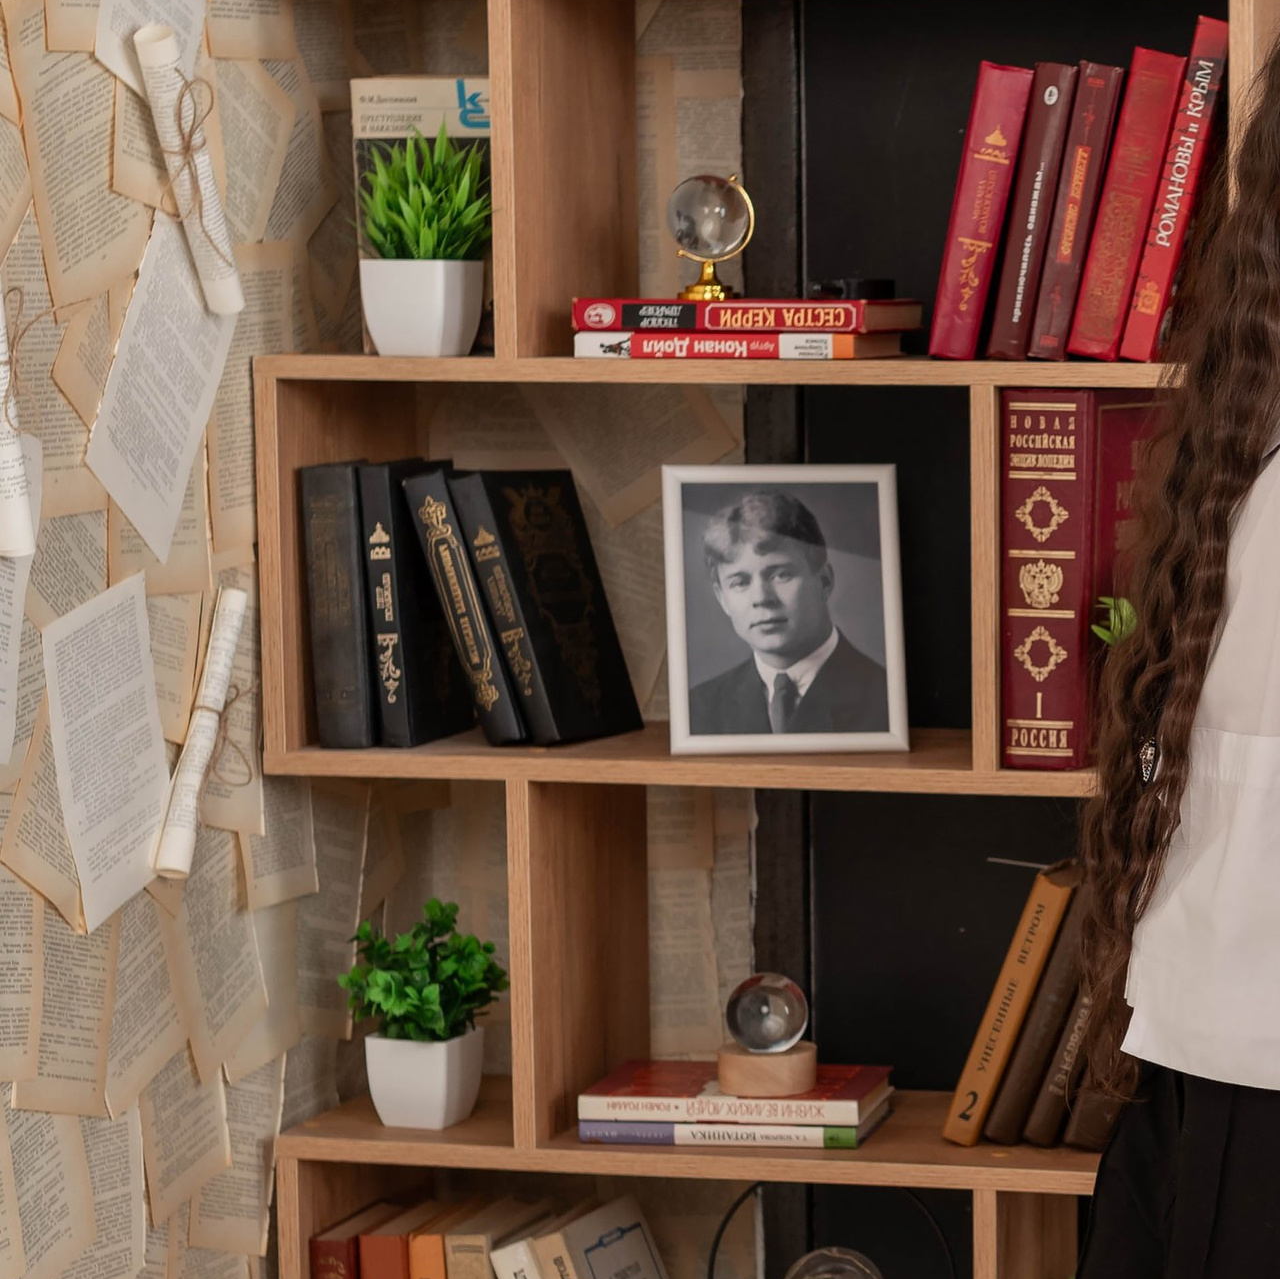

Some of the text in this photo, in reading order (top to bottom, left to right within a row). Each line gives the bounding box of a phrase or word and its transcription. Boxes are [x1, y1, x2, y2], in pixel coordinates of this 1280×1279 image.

[1155, 135, 1195, 248] РОМАНОВЫ
[1186, 60, 1215, 119] КРЫМ
[1011, 234, 1034, 323] приключилось
[639, 305, 682, 317] ДРАЙЗЕР
[720, 307, 845, 328] СЕСТРА КЕРРИ
[640, 317, 678, 328] ТЕОДОР
[643, 336, 775, 357] Артур Конан Дойл
[1010, 416, 1076, 430] НОВАЯ
[1009, 433, 1076, 449] РОССИЙСКАЯ
[1009, 453, 1076, 469] ЭНЦИКЛОПЕДИЯ
[1011, 728, 1068, 749] РОССИЯ
[975, 902, 1046, 1074] УНЕСЕННЫЕ ВЕТРОМ
[641, 1103, 671, 1113] РОМЕН
[686, 1099, 723, 1117] ЛЮДЕЙ
[726, 1102, 778, 1118] ВЕЛИКИХ
[781, 1104, 825, 1119] ЖИЗНИ
[957, 1089, 980, 1123] 2
[690, 1130, 757, 1141] БОТАНИКА
